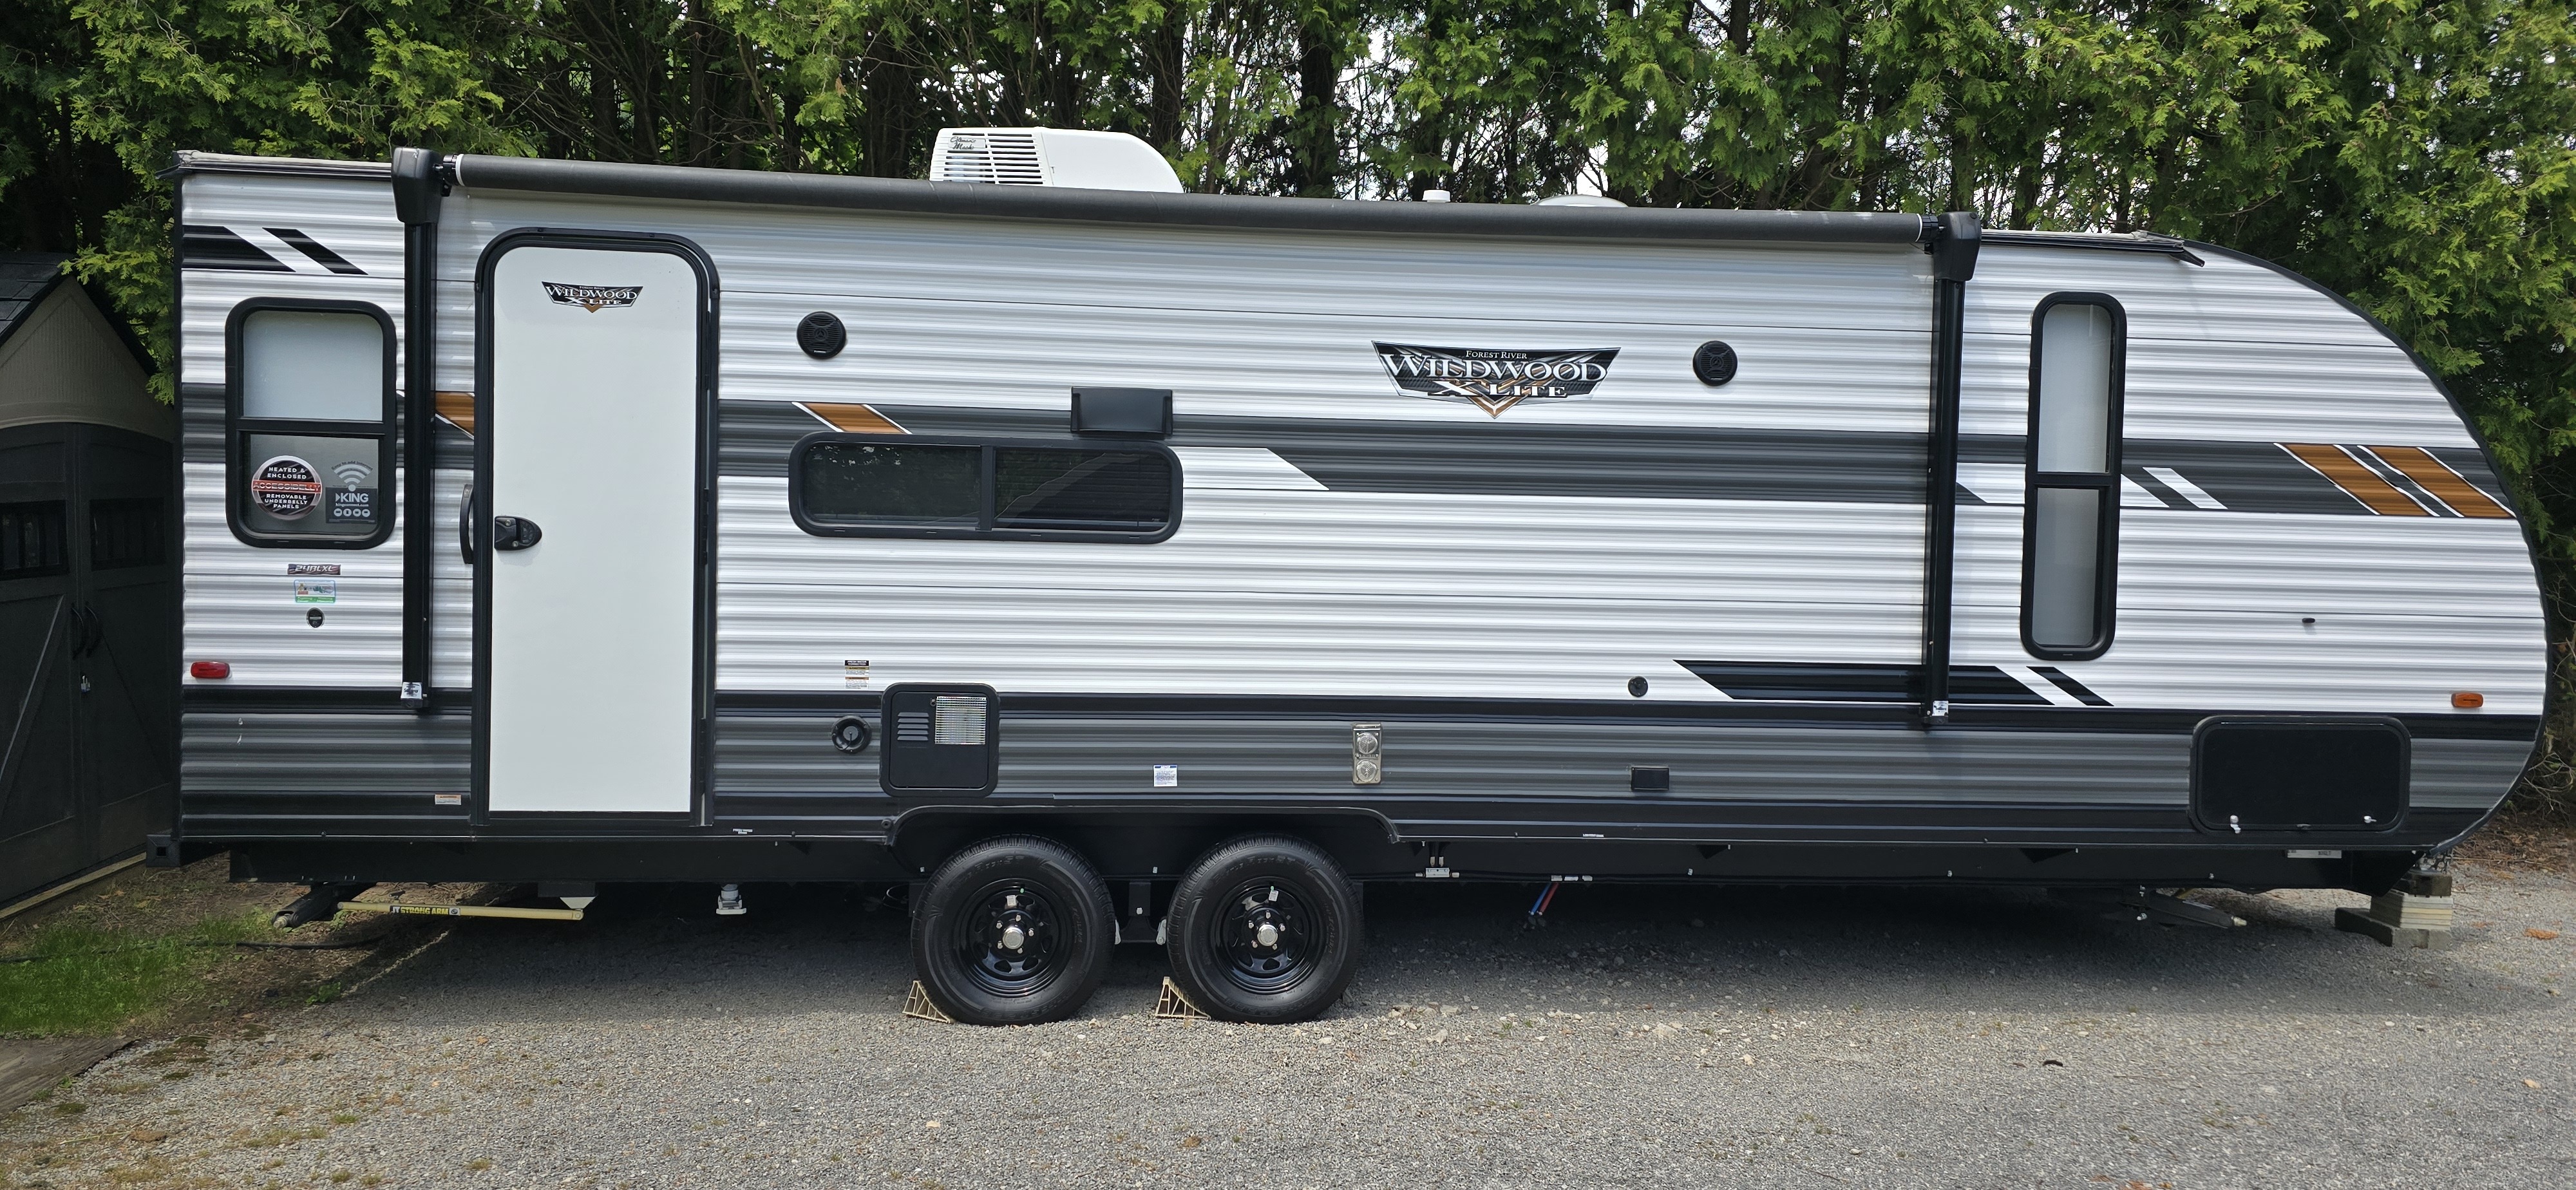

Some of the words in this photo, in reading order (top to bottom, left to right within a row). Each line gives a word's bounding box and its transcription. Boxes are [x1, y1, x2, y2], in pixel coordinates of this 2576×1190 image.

[545, 286, 638, 299] WILDWOOD
[1466, 350, 1499, 359] FOREST
[1501, 351, 1528, 360] RIVER
[1379, 353, 1608, 382] WILDWOOD
[1427, 380, 1483, 397] X
[1489, 383, 1568, 398] LITE
[252, 482, 321, 491] ACCESSIBELLY
[340, 493, 369, 502] KING
[400, 906, 431, 914] STRONG
